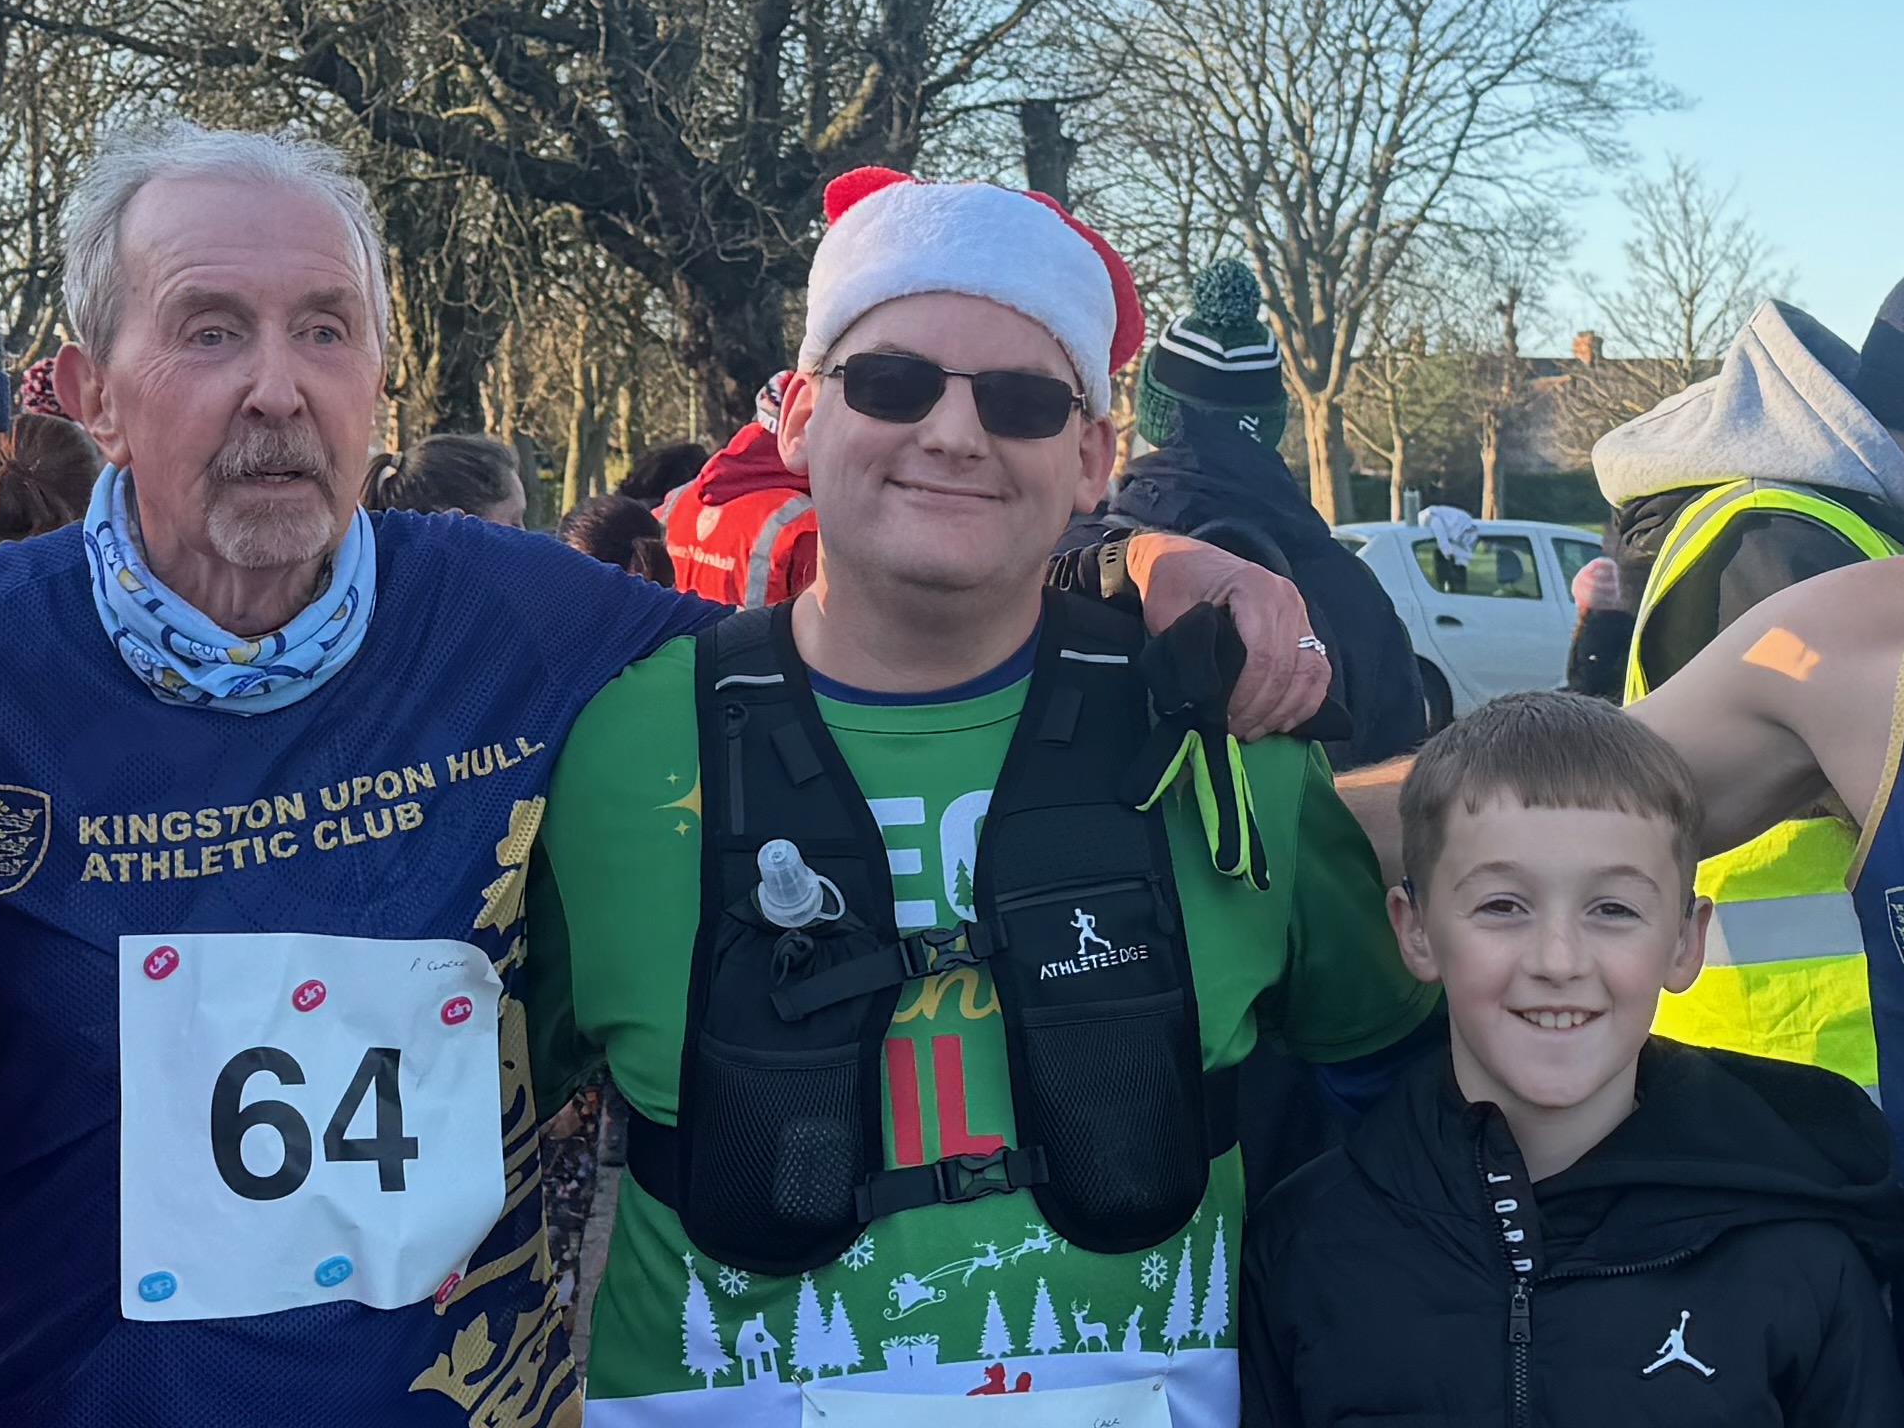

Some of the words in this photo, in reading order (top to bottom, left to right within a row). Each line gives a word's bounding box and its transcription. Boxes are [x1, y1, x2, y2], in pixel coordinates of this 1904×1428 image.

[79, 792, 305, 845] KINGSTON
[320, 762, 436, 812] UPON
[446, 737, 545, 782] HULL
[80, 831, 299, 883] ATHLETIC
[313, 801, 424, 851] CLUB
[210, 1045, 419, 1201] 64
